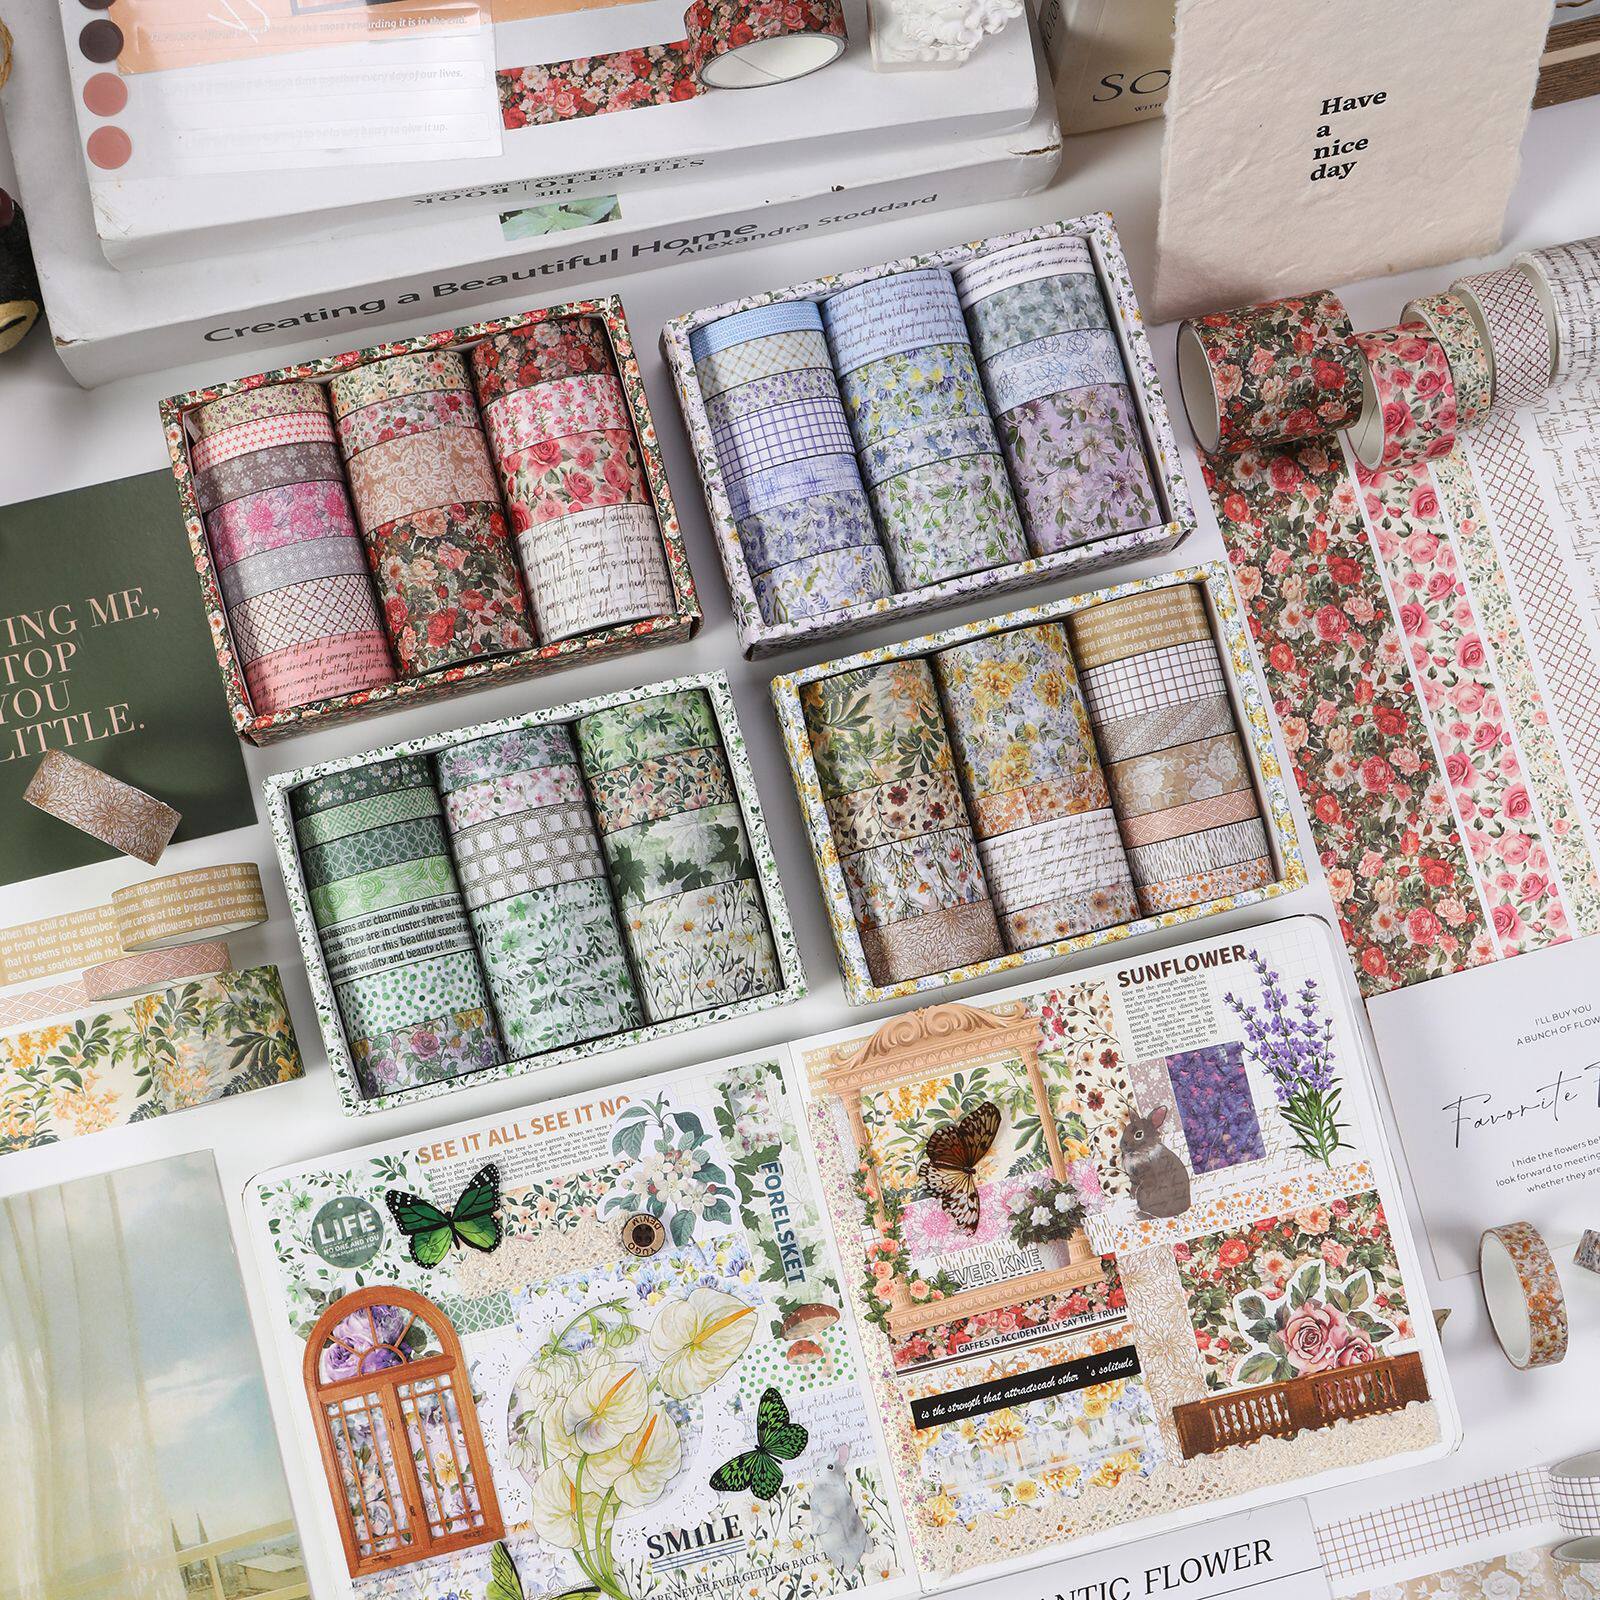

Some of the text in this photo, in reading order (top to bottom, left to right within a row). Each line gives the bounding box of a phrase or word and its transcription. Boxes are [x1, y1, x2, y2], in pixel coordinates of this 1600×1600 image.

[400, 18, 407, 27] it
[408, 18, 416, 26] is
[418, 17, 427, 25] in
[390, 72, 408, 82] day
[409, 71, 420, 82] of
[420, 71, 438, 80] our
[439, 69, 463, 79] lives.
[1319, 88, 1388, 117] Have
[424, 122, 432, 131] it
[434, 122, 448, 133] up.
[1316, 123, 1331, 138] a
[1312, 134, 1369, 160] nice
[535, 159, 705, 188] STILETTO
[1310, 157, 1358, 182] day
[412, 185, 510, 206] BOOK
[534, 187, 575, 199] THE
[677, 194, 938, 257] Alexandra Stoddard
[203, 220, 759, 344] Creating a Beautiful Home
[85, 586, 160, 628] ME,
[0, 641, 77, 685] TOP
[183, 886, 206, 900] color
[25, 926, 38, 936] the
[40, 921, 58, 932] chill
[60, 917, 68, 927] of
[70, 911, 97, 925] winter
[358, 919, 372, 930] are
[373, 905, 420, 925] charmingly
[366, 931, 380, 941] are
[381, 927, 391, 937] in
[392, 917, 427, 934] clusters
[428, 913, 444, 925] here
[2, 946, 13, 956] up
[14, 940, 35, 952] from
[37, 934, 57, 947] their
[368, 944, 380, 955] for
[382, 939, 399, 951] this
[400, 929, 437, 947] beautiful
[438, 926, 456, 937] scene
[5, 945, 71, 969] that seems to
[360, 957, 387, 972] vitality
[388, 951, 405, 964] and
[405, 944, 434, 959] beauty
[435, 941, 445, 952] of
[445, 939, 459, 950] life.
[1117, 944, 1247, 988] SUNFLOWER
[1157, 979, 1179, 988] strength
[1535, 1004, 1592, 1026] I'LL BUY YOU
[1517, 1038, 1524, 1046] A
[1524, 1028, 1558, 1044] BUNCH
[1559, 1023, 1572, 1034] OF
[1441, 1070, 1582, 1148] Favorite
[418, 1140, 458, 1164] SEE
[462, 1132, 481, 1153] IT
[488, 1123, 527, 1147] ALL
[530, 1111, 571, 1136] SEE
[574, 1103, 594, 1125] IT
[1516, 1155, 1536, 1166] hide
[1537, 1151, 1553, 1161] the
[1554, 1141, 1586, 1155] flowers
[1496, 1151, 1600, 1187] look forward to meeting
[1526, 1177, 1564, 1193] whether
[1565, 1171, 1586, 1182] they
[317, 1209, 376, 1245] LIFE
[761, 1162, 806, 1283] FORELSKET
[324, 1248, 334, 1256] NO
[350, 1238, 364, 1248] AND
[365, 1234, 380, 1244] YOU
[958, 1306, 1127, 1354] GAFFES IS ACCIDENTALLY SAY THE TRUTH
[921, 1409, 930, 1420] is
[932, 1405, 947, 1417] the
[947, 1395, 981, 1415] strength
[983, 1391, 1003, 1405] that
[1057, 1372, 1080, 1387] other
[1098, 1359, 1134, 1375] solitude
[647, 1514, 744, 1560] SMILE
[673, 1583, 711, 1600] NEVER
[712, 1576, 740, 1595] EVER
[742, 1562, 791, 1583] GETTING
[792, 1553, 821, 1570] BACK
[1144, 1539, 1273, 1595] FLOWER
